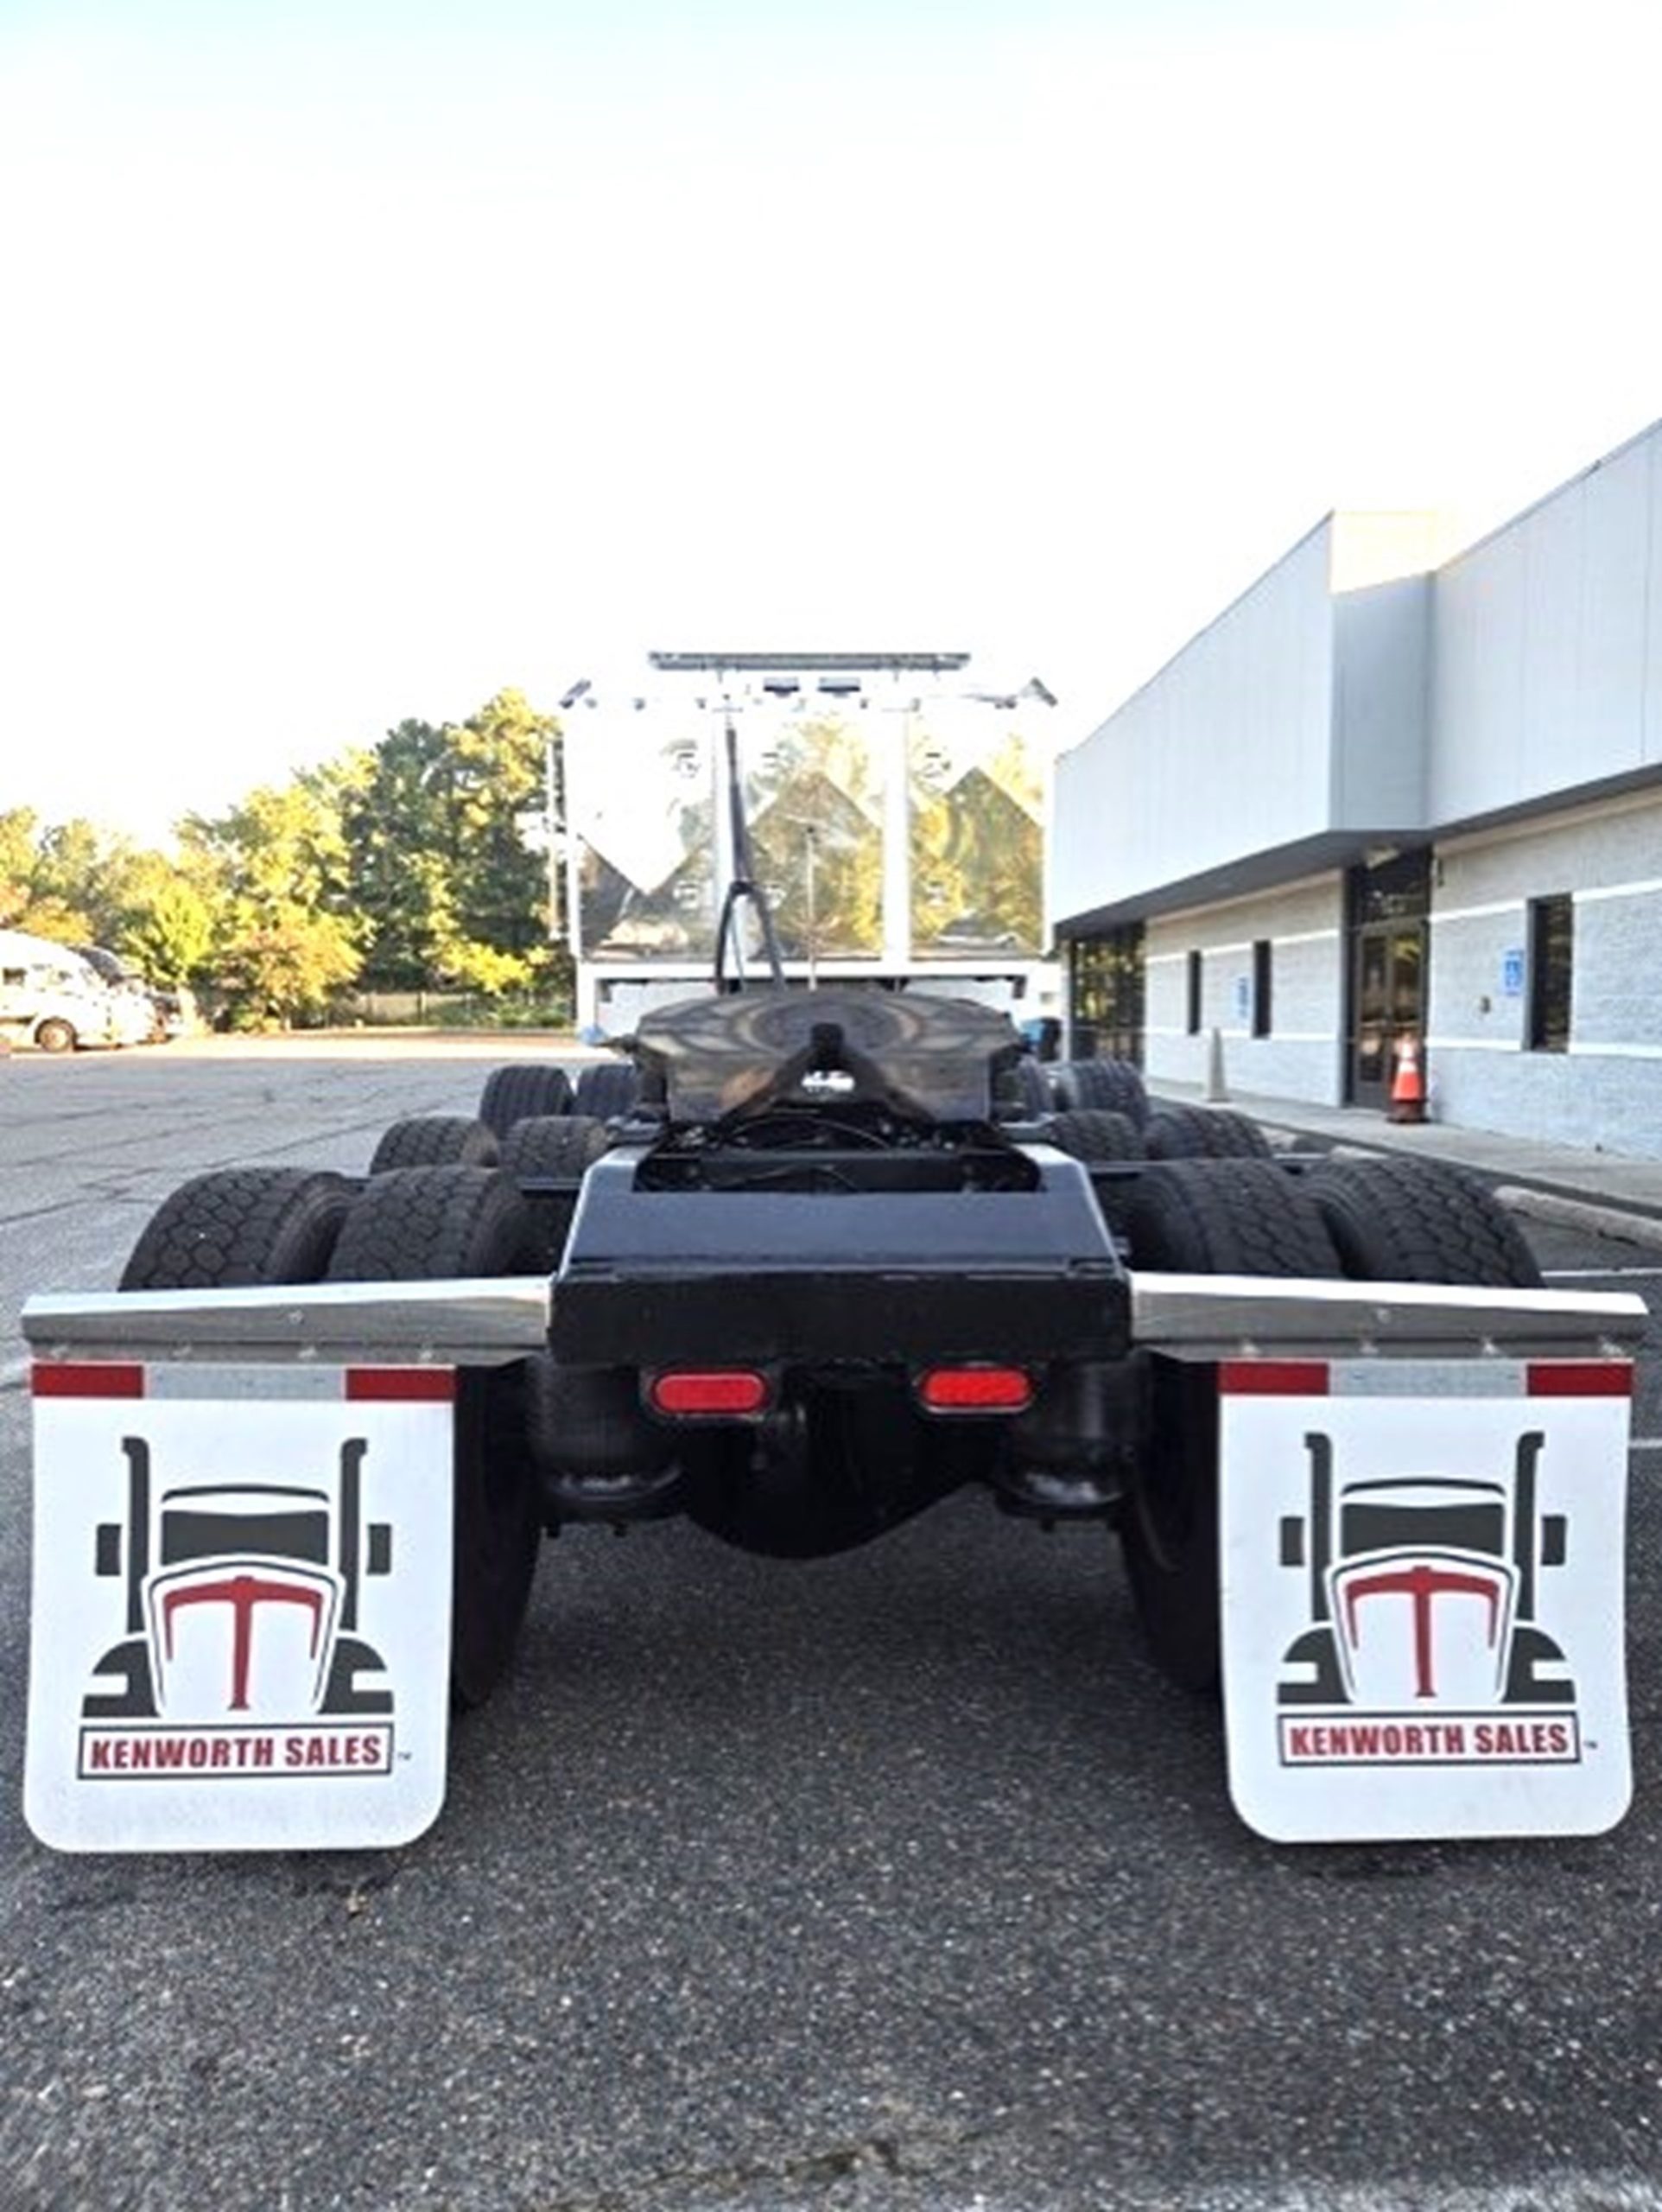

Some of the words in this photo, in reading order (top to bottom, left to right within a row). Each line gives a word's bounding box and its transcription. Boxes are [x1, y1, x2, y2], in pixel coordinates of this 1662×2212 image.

[91, 1738, 273, 1769] KENWORTH
[284, 1735, 381, 1766] SALES
[1291, 1726, 1464, 1755] KENWORTH
[1475, 1724, 1568, 1753] SALES
